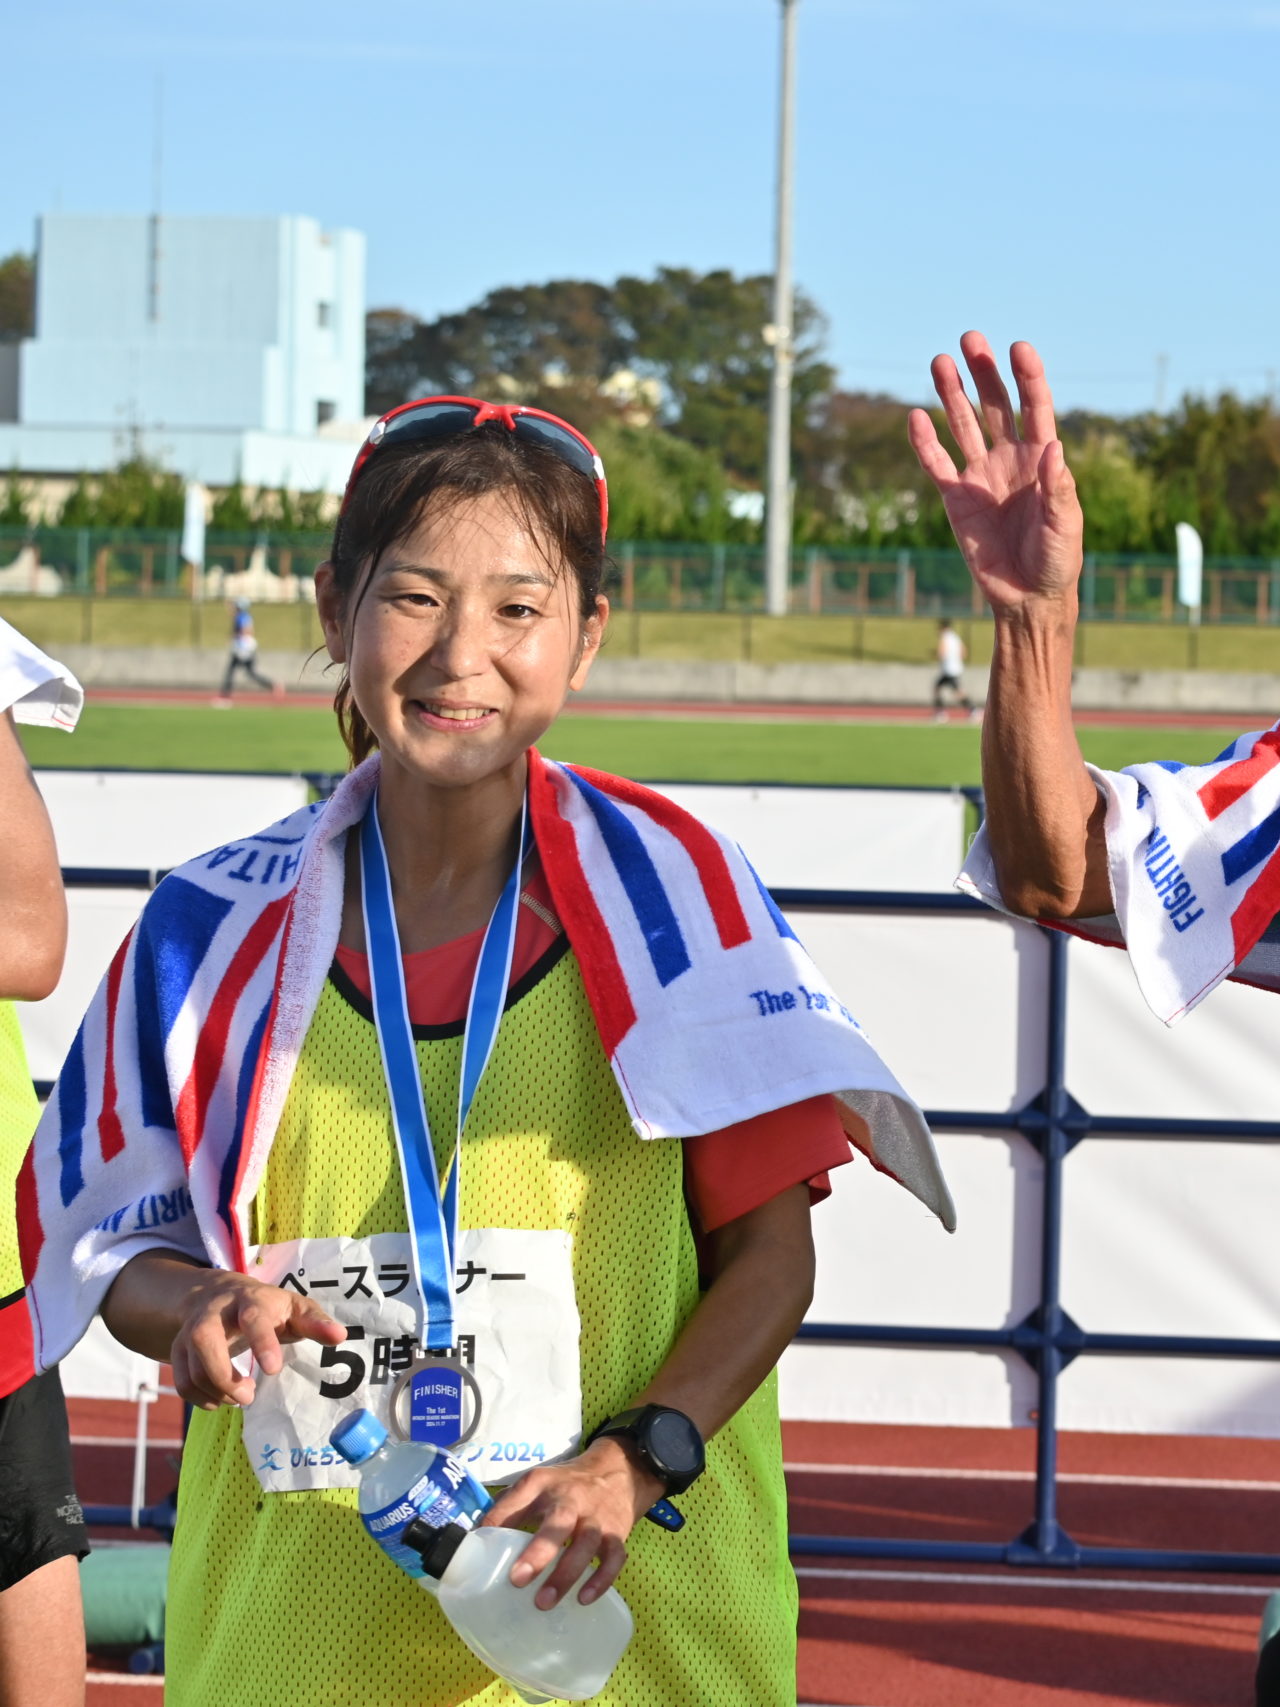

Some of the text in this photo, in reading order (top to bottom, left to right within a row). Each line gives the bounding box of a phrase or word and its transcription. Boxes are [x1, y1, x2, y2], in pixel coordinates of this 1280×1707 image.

[749, 990, 797, 1016] The
[279, 1260, 526, 1299] ペースラナー
[414, 1384, 458, 1400] FINISHER
[490, 1442, 546, 1462] 2024
[369, 1502, 415, 1532] AQUARIUS
